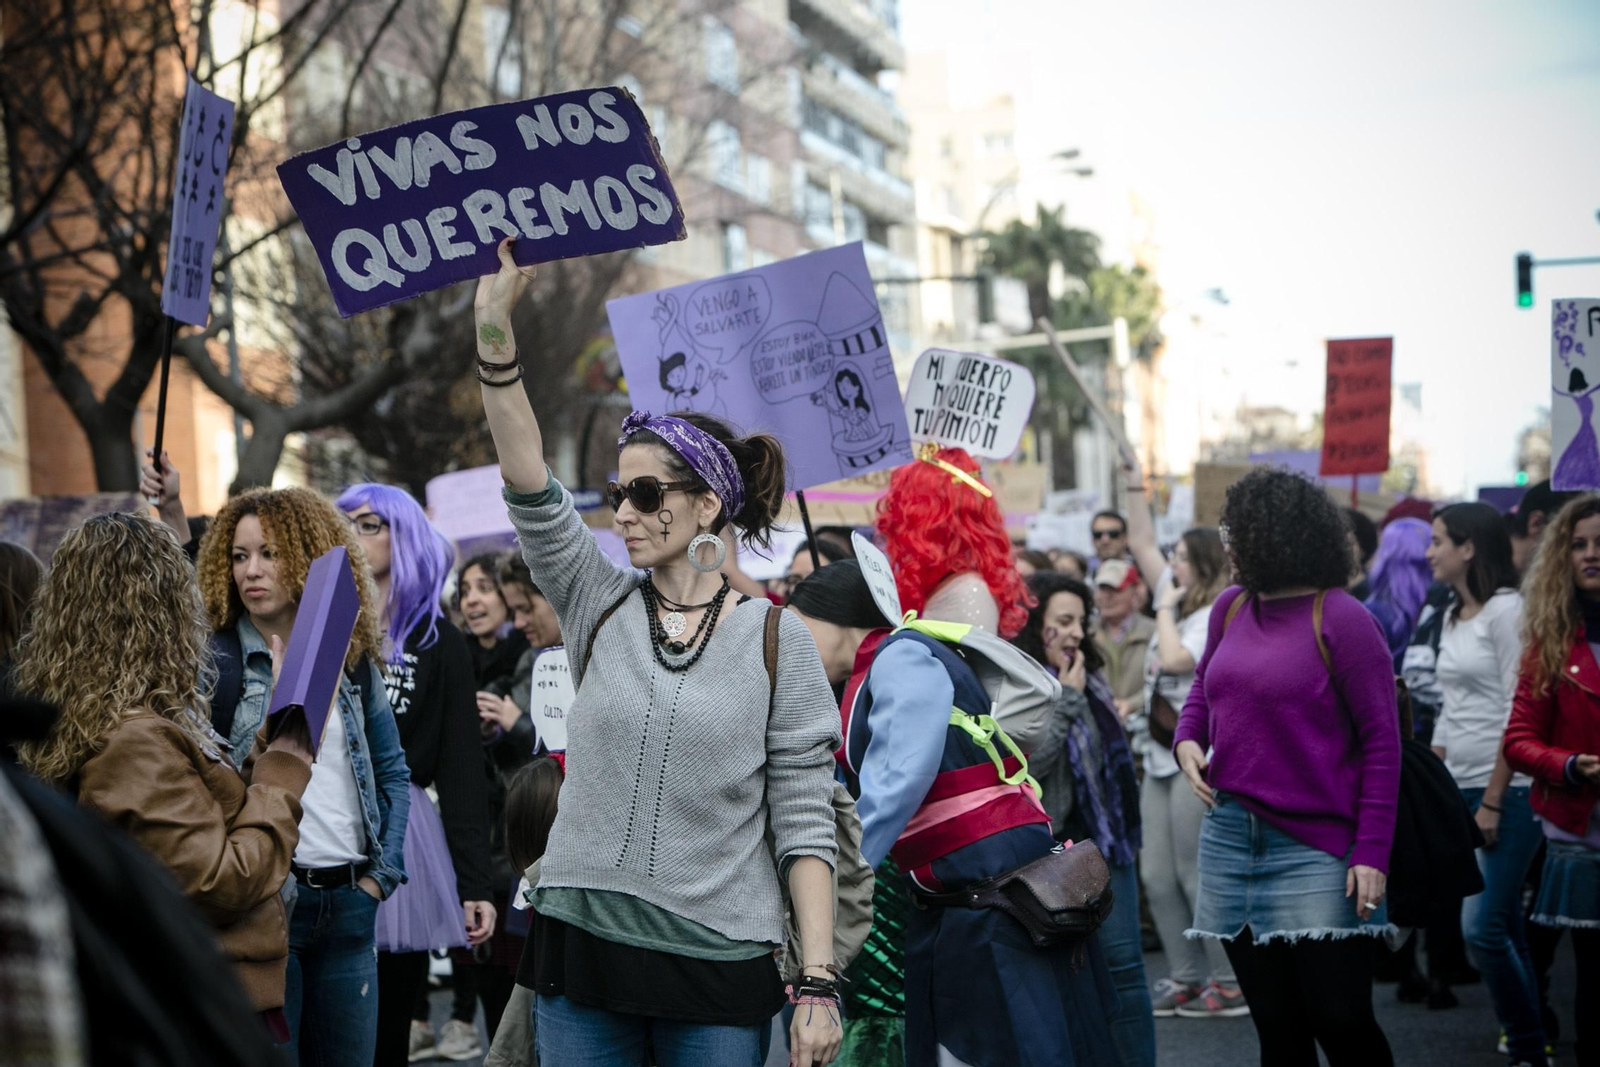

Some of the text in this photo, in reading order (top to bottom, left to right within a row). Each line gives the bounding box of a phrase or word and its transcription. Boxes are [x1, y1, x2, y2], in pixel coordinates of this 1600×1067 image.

[515, 91, 630, 150] NOS
[331, 164, 673, 292] QUEREMOS
[692, 284, 759, 318] VENGO A
[695, 306, 761, 336] SALVARTE
[761, 337, 790, 353] ESTOY
[927, 355, 945, 381] MI
[948, 384, 1006, 420] QUIERE
